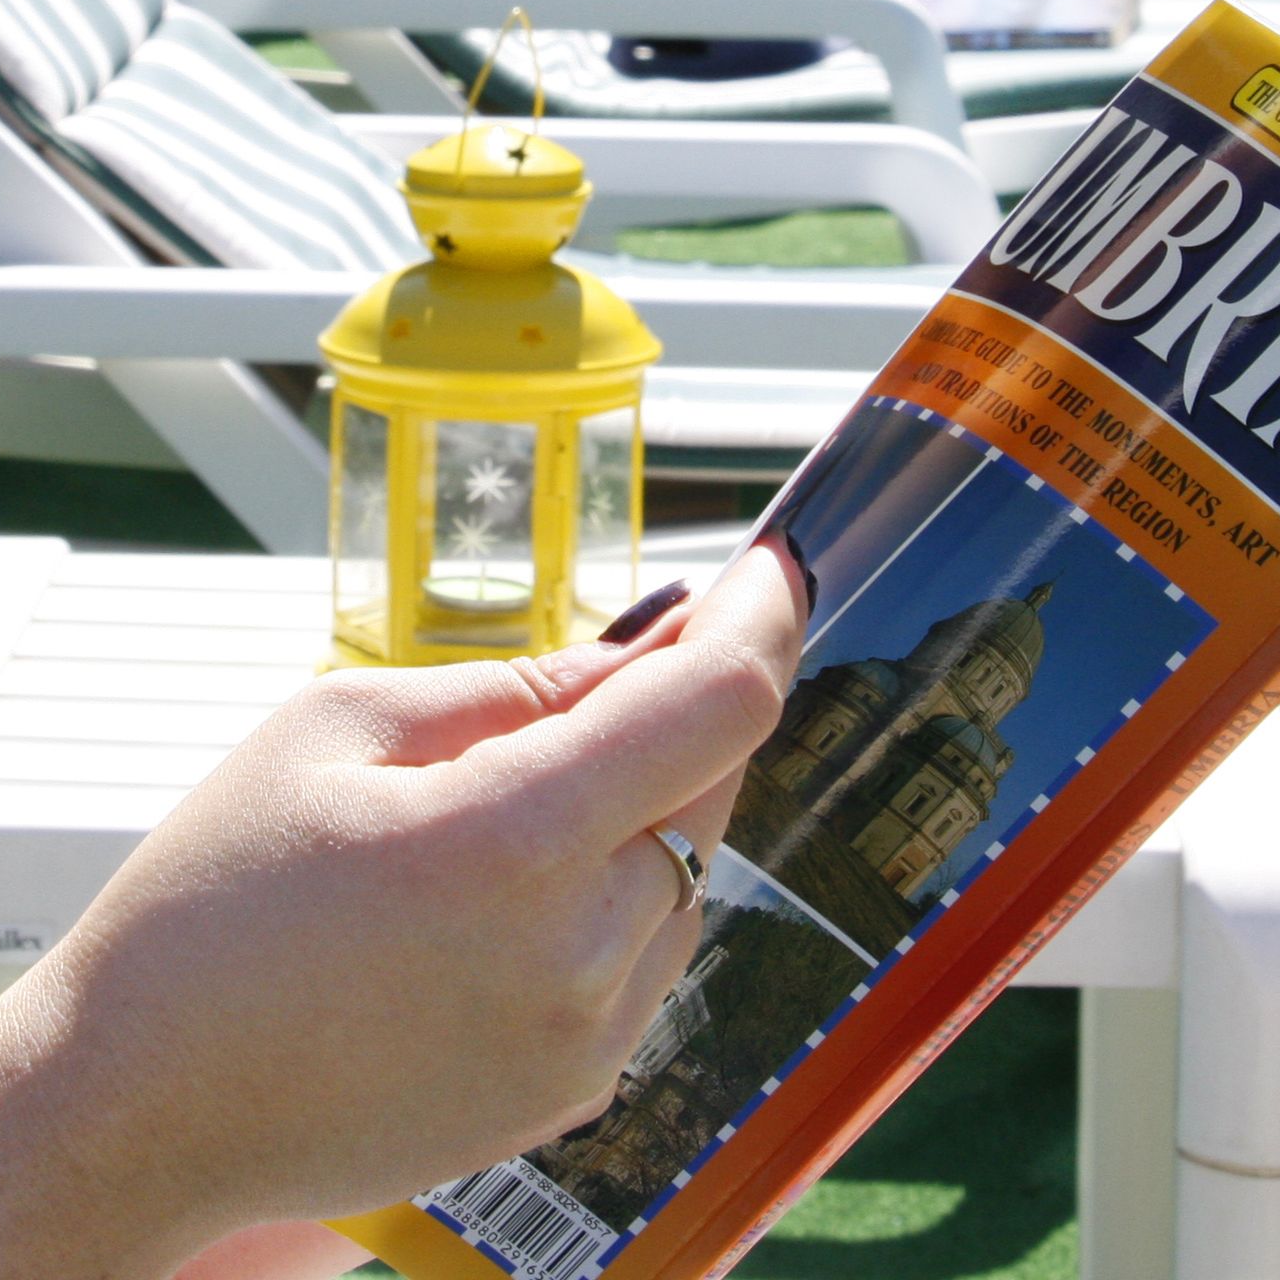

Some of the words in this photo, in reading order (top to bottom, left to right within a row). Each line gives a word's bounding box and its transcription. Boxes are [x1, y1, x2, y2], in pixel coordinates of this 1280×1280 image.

[934, 368, 1037, 435] TRADITIONS
[1029, 424, 1064, 452] OF
[1057, 442, 1106, 488] THE
[1101, 476, 1191, 555] REGION
[974, 336, 1029, 376] GUIDE
[1021, 361, 1054, 391] TO
[1047, 378, 1095, 420] THE
[1086, 408, 1223, 527] MONUMENTS,
[1221, 520, 1280, 567] ART
[432, 1190, 443, 1202] 9
[444, 1199, 499, 1244] 788880
[499, 1242, 557, 1280] 29165
[518, 1162, 613, 1238] 978-88-8029-165-7
